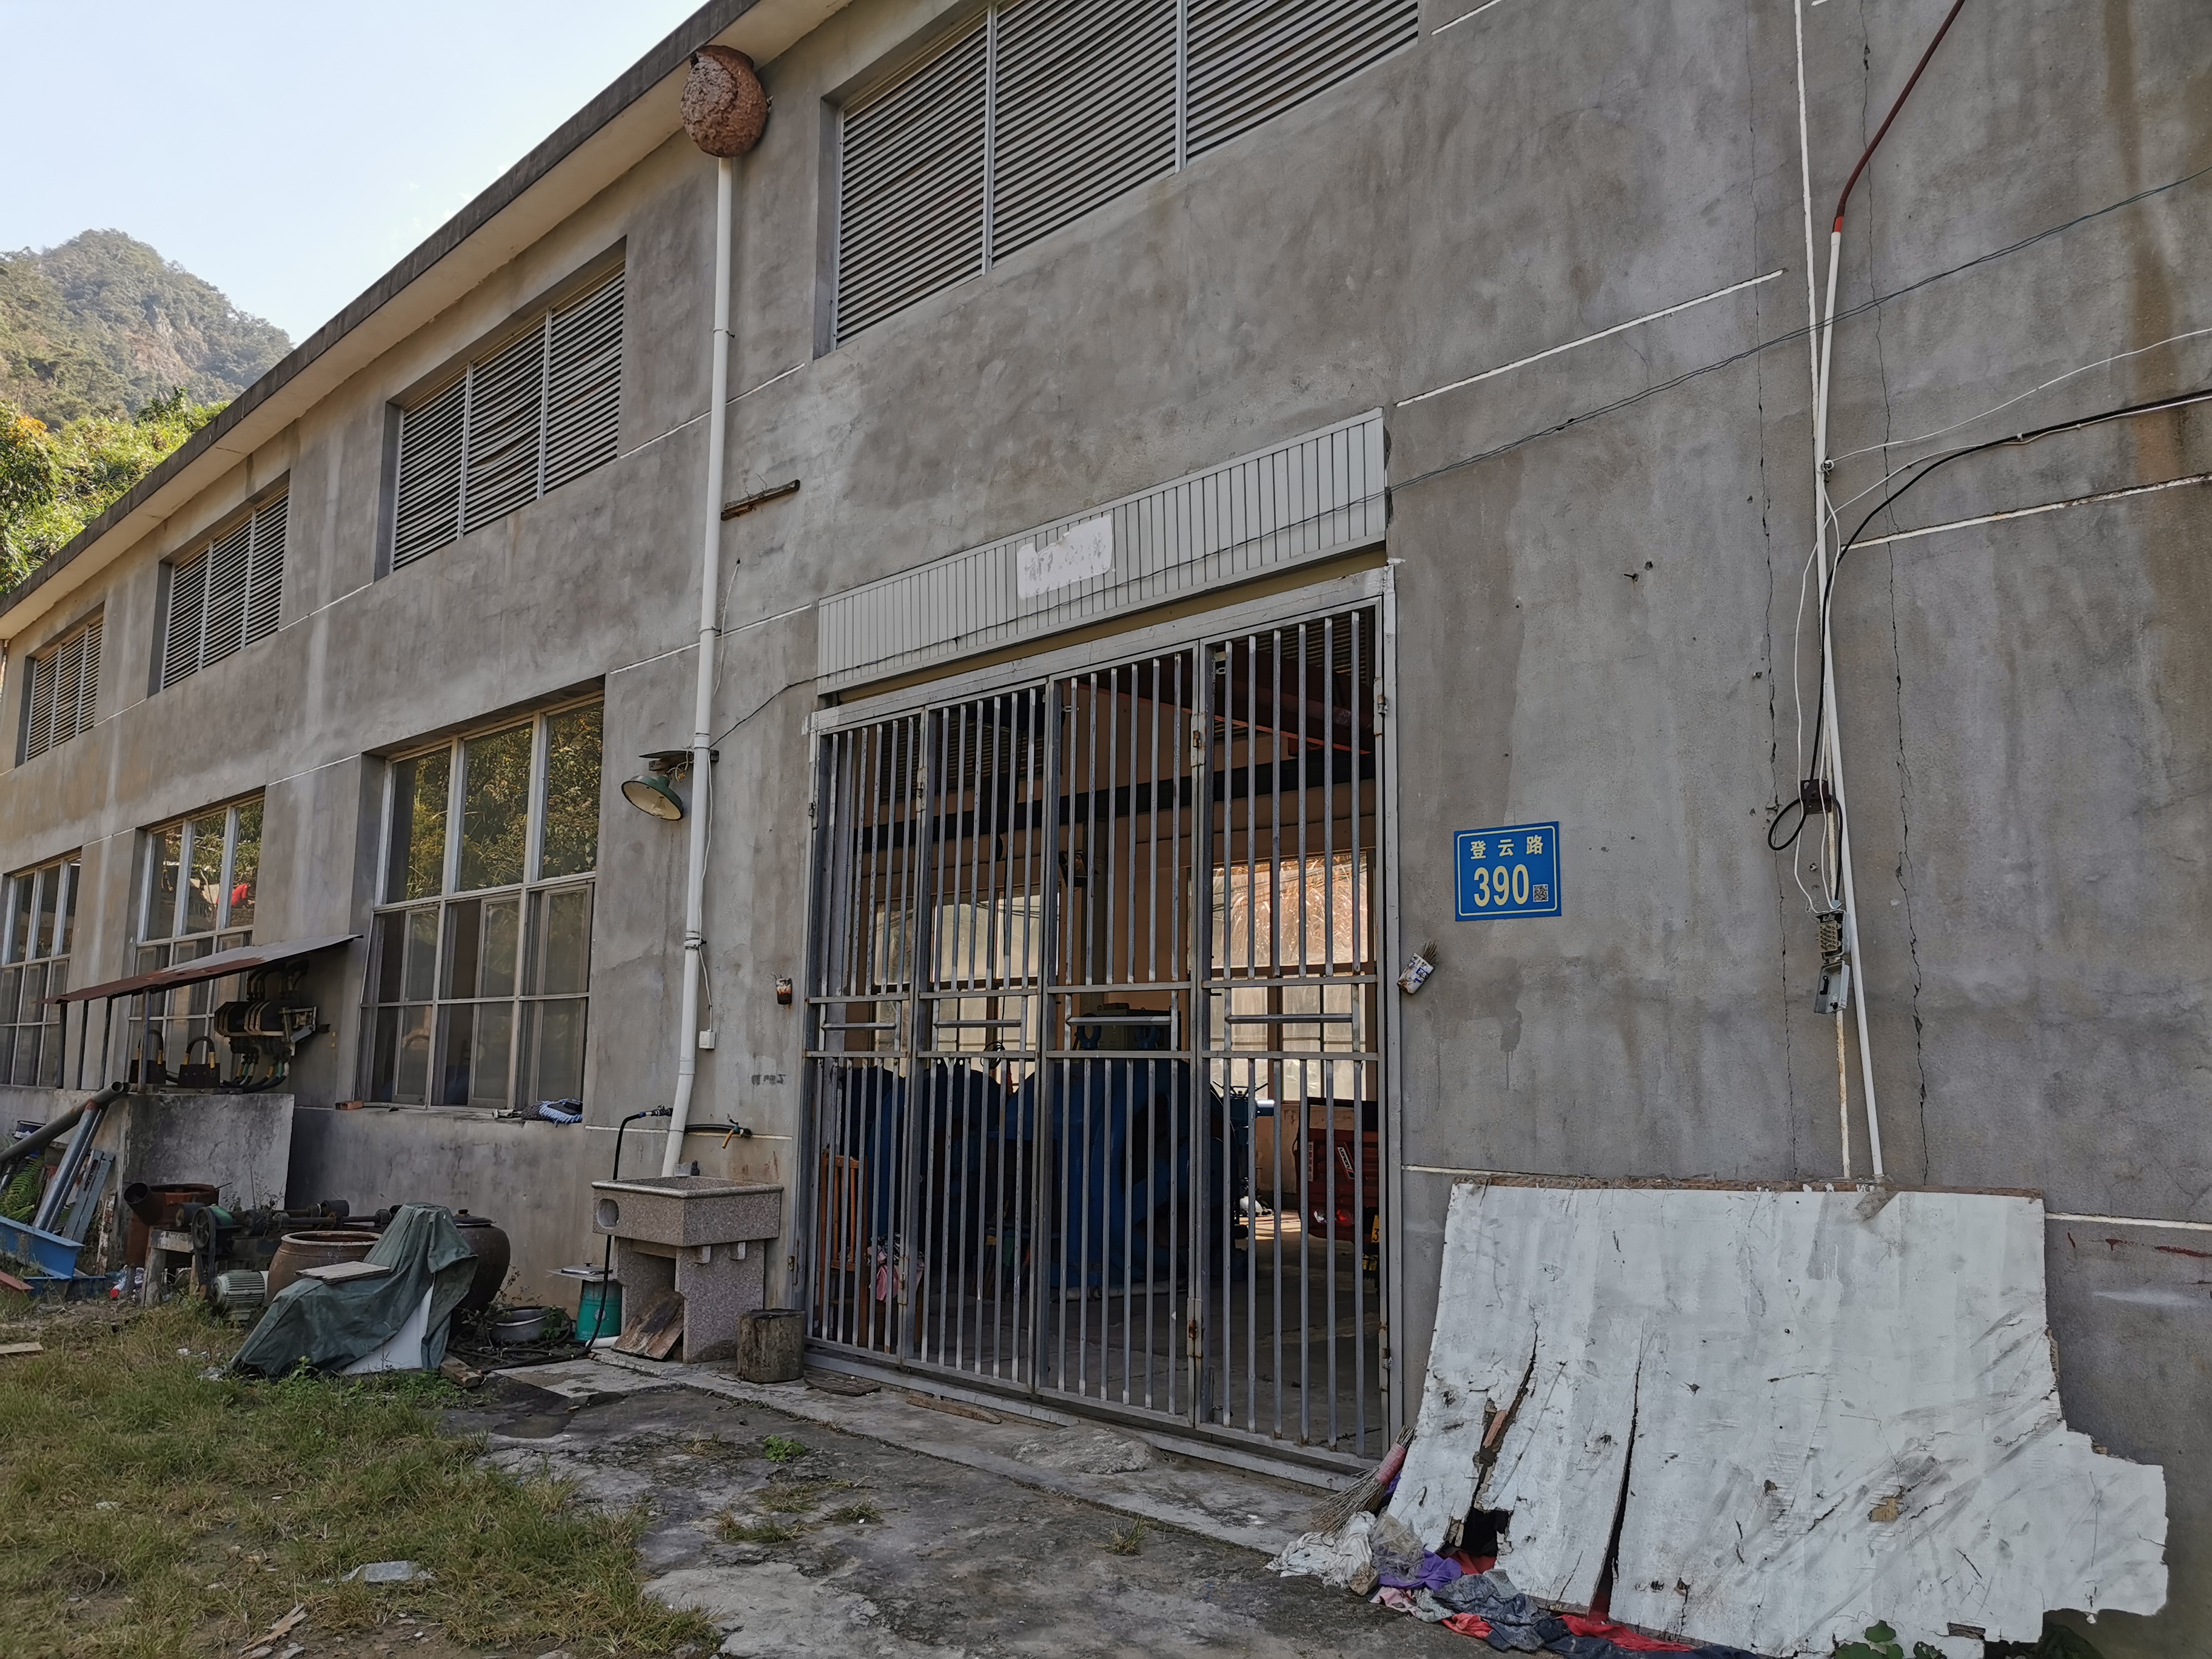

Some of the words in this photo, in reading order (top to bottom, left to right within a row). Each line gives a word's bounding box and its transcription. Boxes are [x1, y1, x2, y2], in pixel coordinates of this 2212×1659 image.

[1470, 834, 1544, 860] 登云路
[1473, 863, 1529, 907] 390
